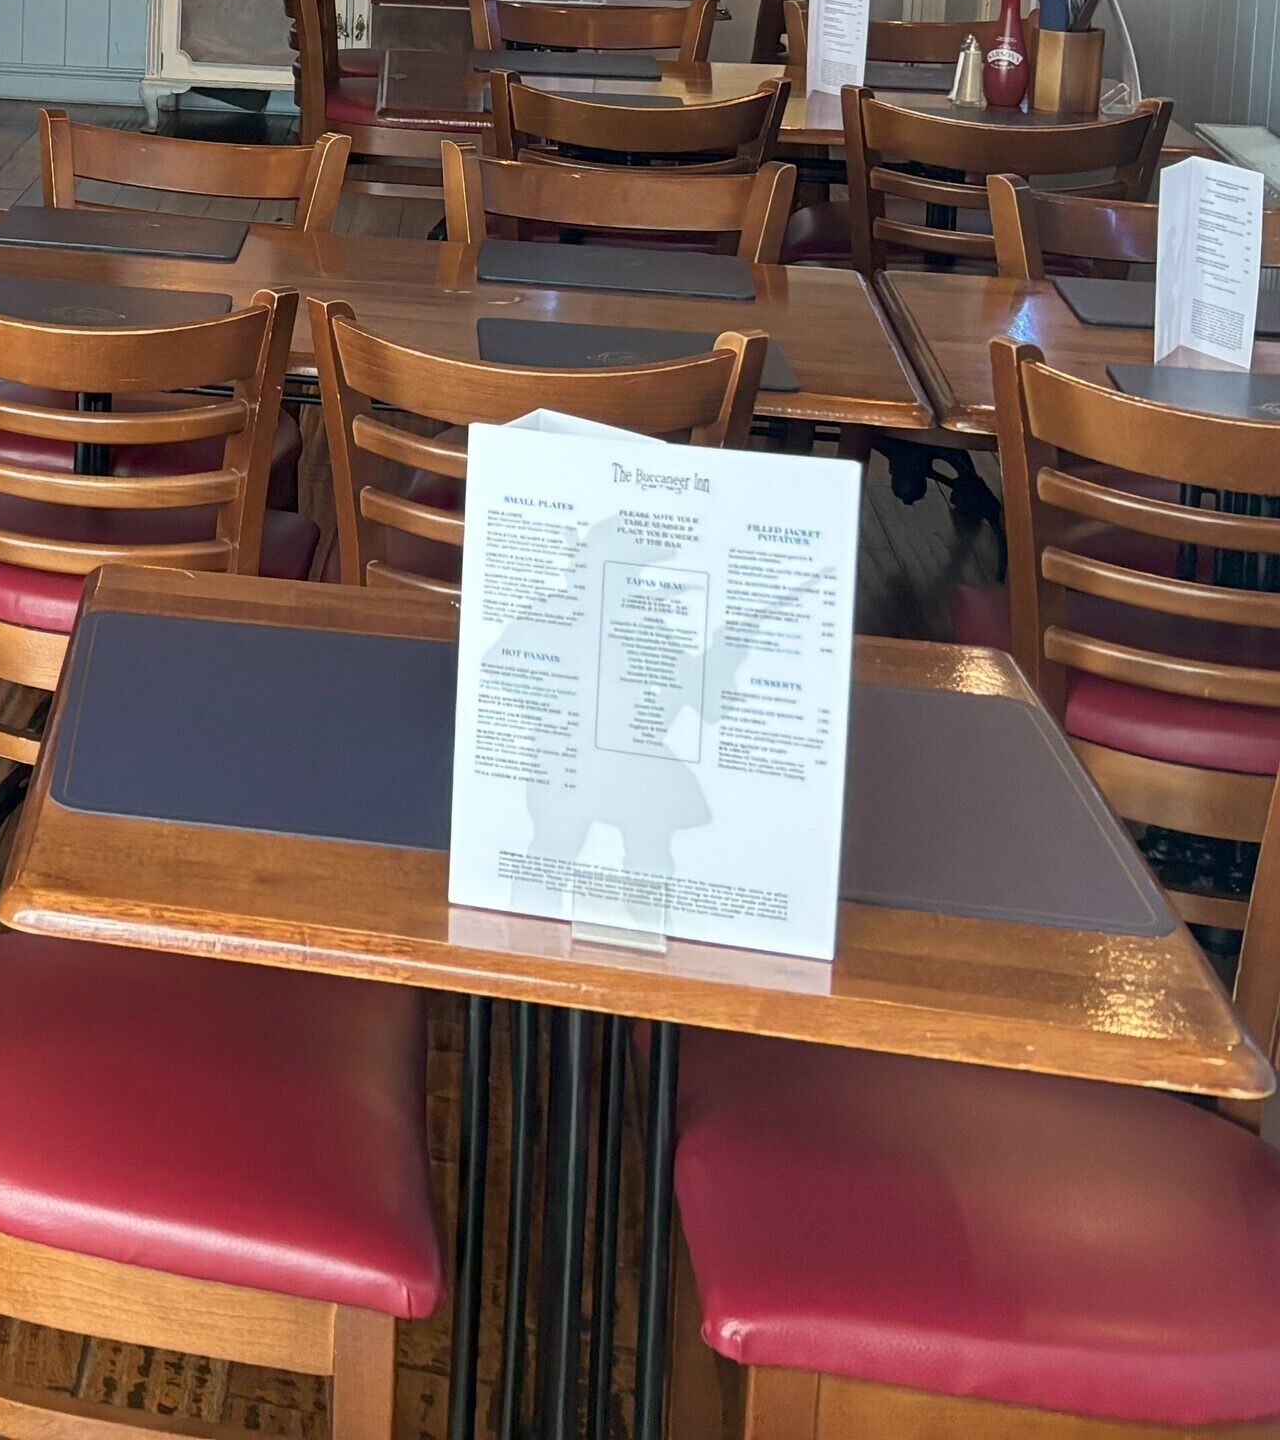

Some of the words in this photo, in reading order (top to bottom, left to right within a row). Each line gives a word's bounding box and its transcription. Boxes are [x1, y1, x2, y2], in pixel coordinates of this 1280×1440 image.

[612, 462, 632, 483] The
[636, 468, 690, 490] Buccaneer
[694, 472, 710, 493] Inn
[504, 496, 535, 507] SMALL
[538, 499, 574, 511] PLATES
[747, 524, 782, 534] FILLED
[785, 528, 821, 539] JACKET
[758, 533, 810, 546] POTATOES
[626, 577, 656, 588] TAPAS
[659, 581, 687, 592] MENU
[501, 647, 522, 658] HOT
[750, 677, 802, 691] DESSERTS
